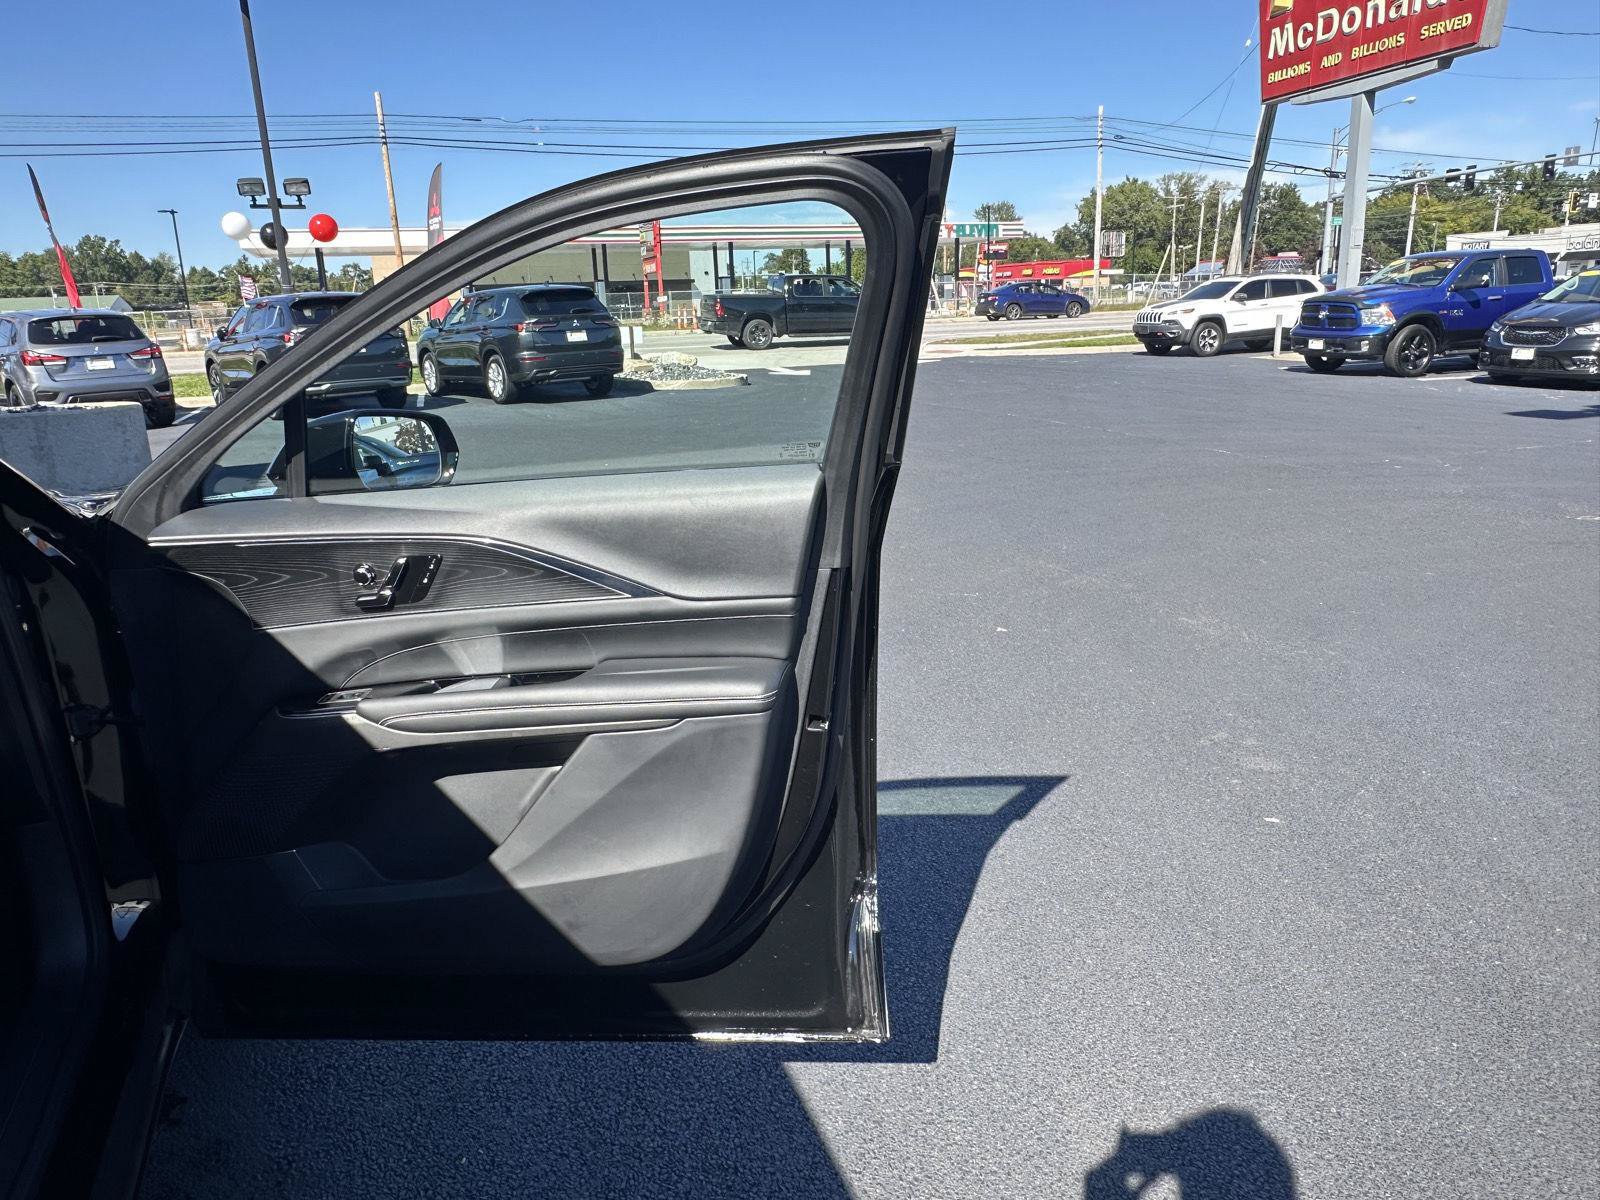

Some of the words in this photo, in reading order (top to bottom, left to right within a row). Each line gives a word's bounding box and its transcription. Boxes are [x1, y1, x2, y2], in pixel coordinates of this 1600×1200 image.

[1267, 61, 1311, 83] BILLIONS
[1320, 52, 1342, 69] AND
[1351, 32, 1405, 60] BILLIONS
[1420, 12, 1473, 40] SERVED
[1268, 0, 1447, 60] McDona
